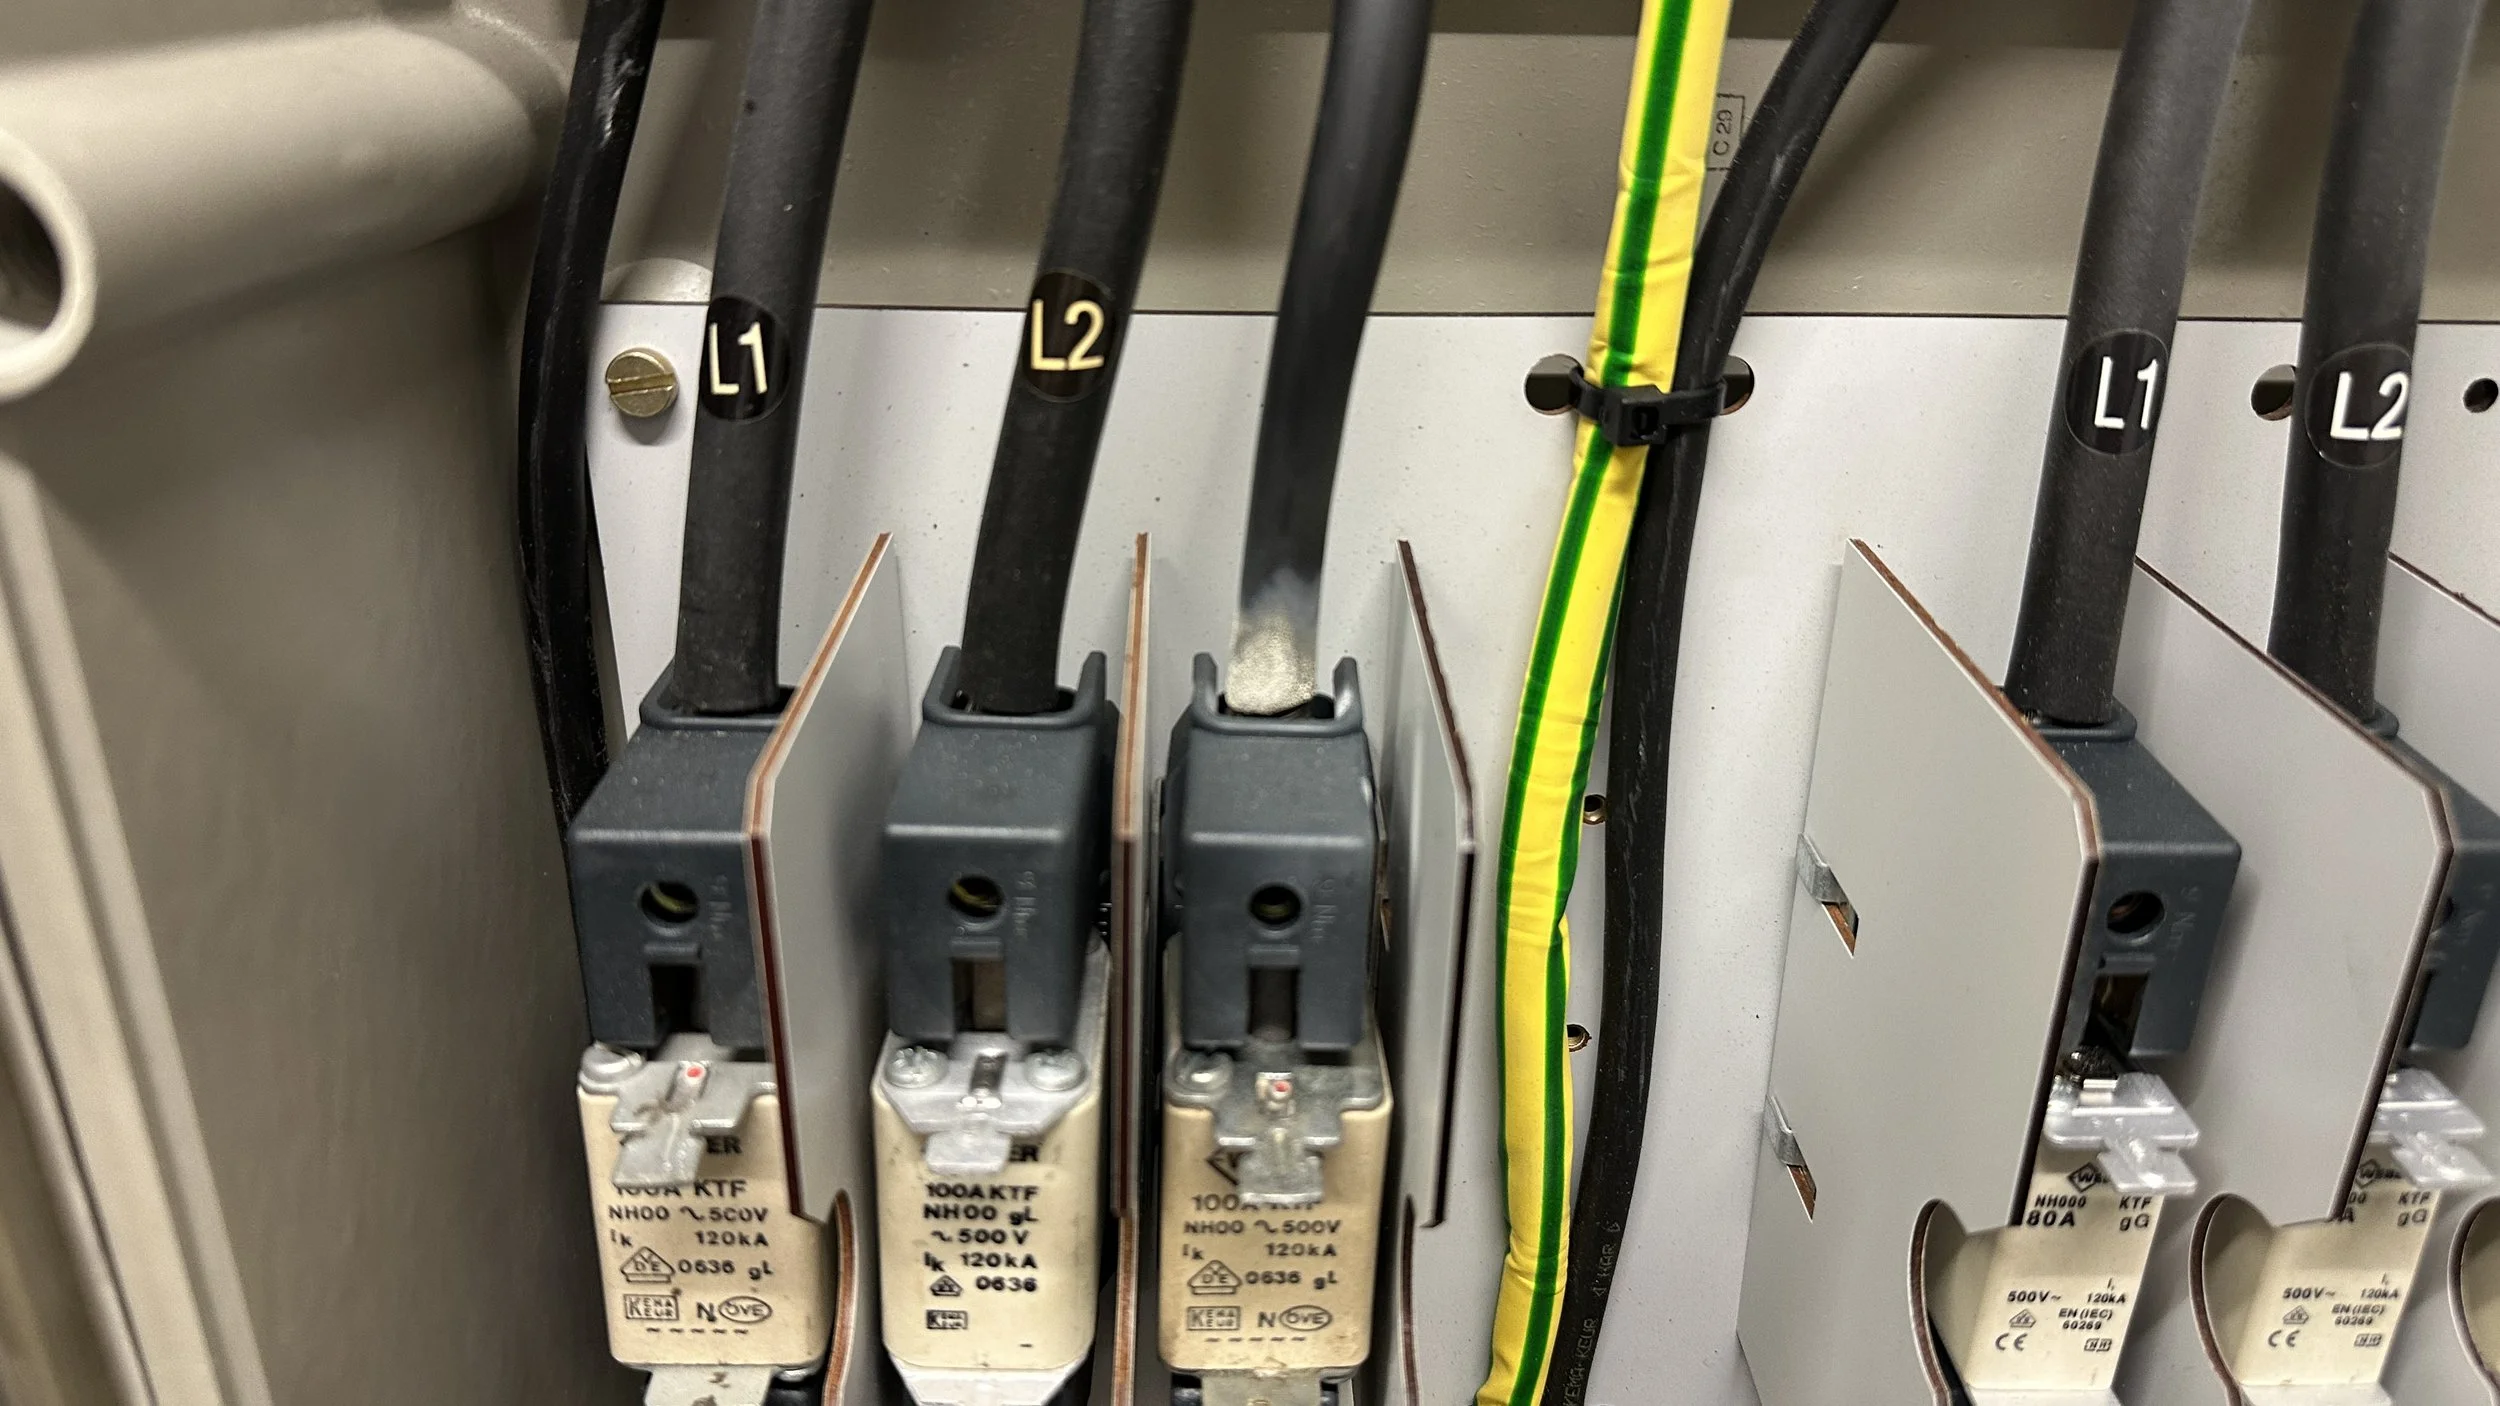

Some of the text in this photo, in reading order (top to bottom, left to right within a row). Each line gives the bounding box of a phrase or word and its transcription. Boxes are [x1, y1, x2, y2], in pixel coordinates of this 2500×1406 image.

[1712, 139, 1731, 156] C
[1029, 299, 1105, 372] L2
[708, 321, 768, 396] L1
[2094, 355, 2158, 431] L1
[2330, 371, 2410, 441] L2
[694, 1179, 747, 1197] KTF
[924, 1181, 1040, 1201] 100A KTF
[2034, 1194, 2153, 1210] NH000 KTF
[608, 1205, 670, 1220] NH00
[924, 1203, 1039, 1226] NH00 gL
[2026, 1210, 2076, 1227] 80A
[1183, 1220, 1245, 1235] NH00
[2087, 1292, 2127, 1304] 120kA
[2058, 1308, 2113, 1321] EN (IEC)
